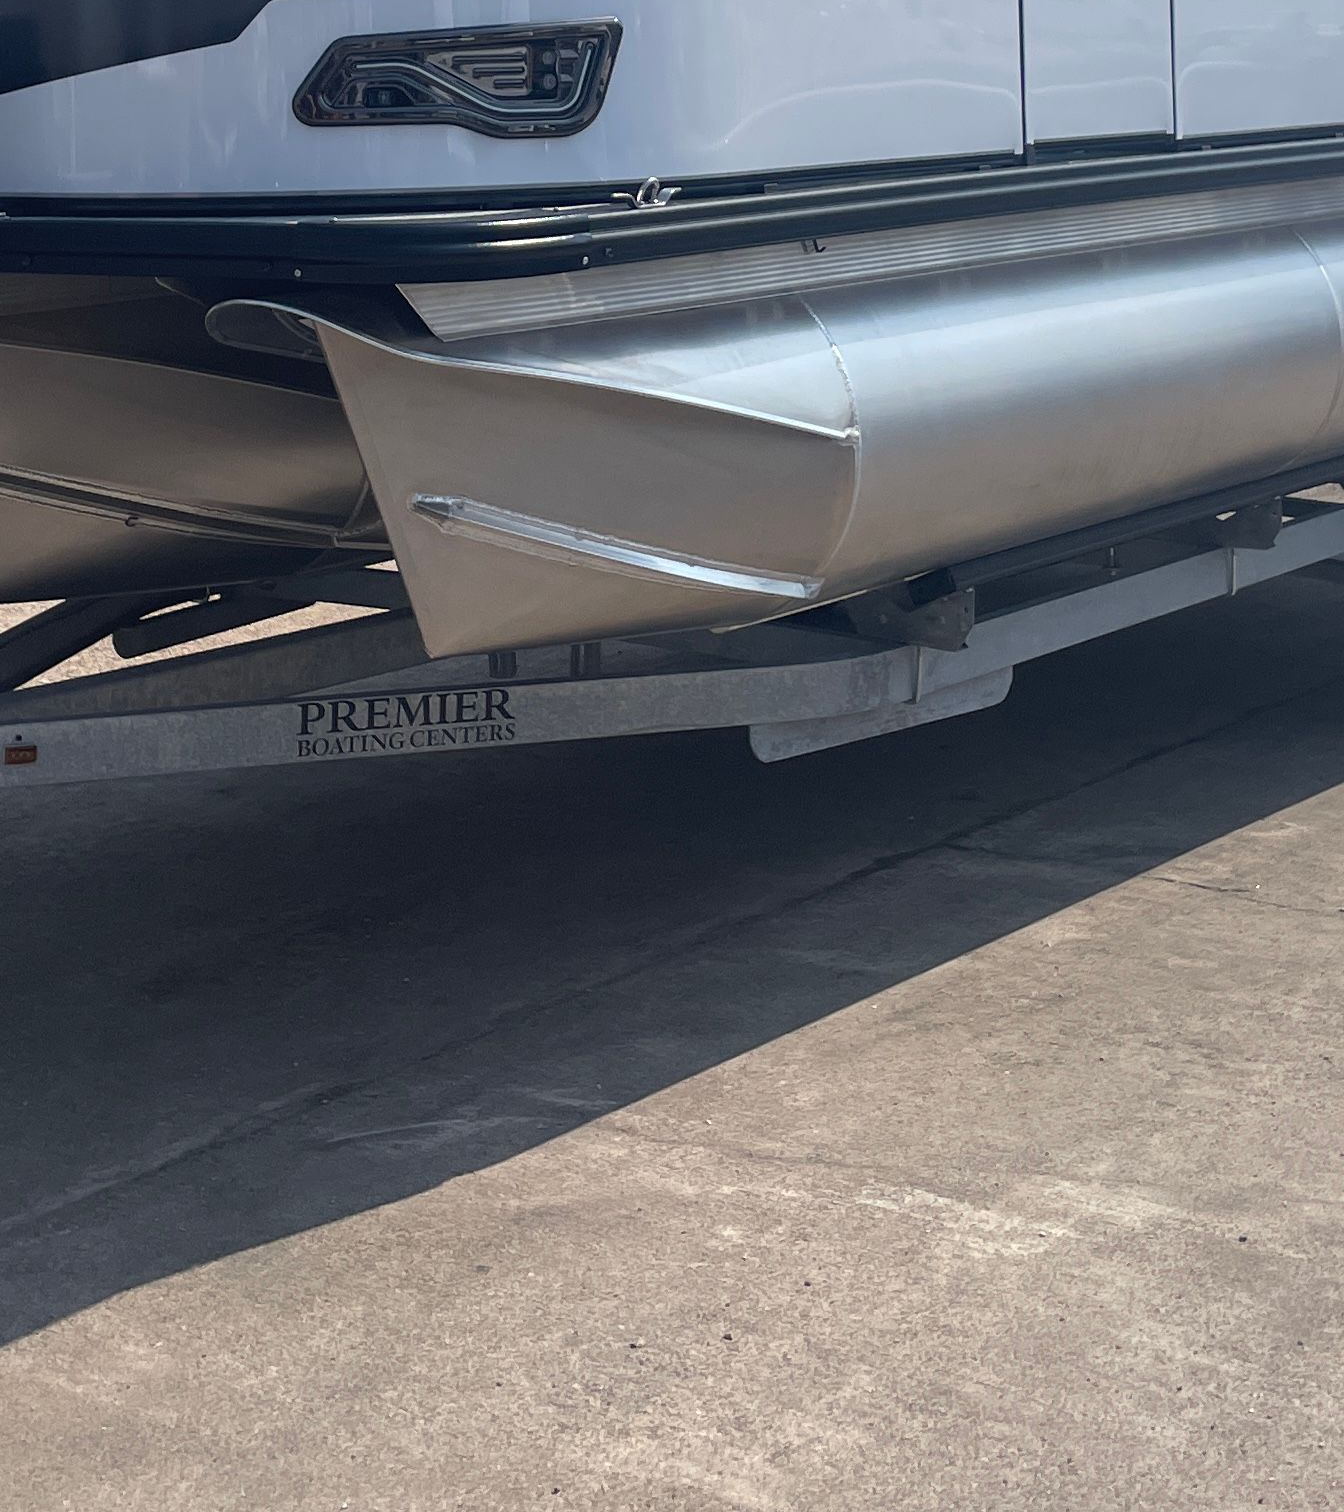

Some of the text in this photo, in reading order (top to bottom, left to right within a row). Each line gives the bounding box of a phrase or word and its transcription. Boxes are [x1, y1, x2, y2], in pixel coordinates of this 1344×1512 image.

[296, 688, 516, 736] PREMIER
[296, 722, 516, 758] BOATING CENTERS
